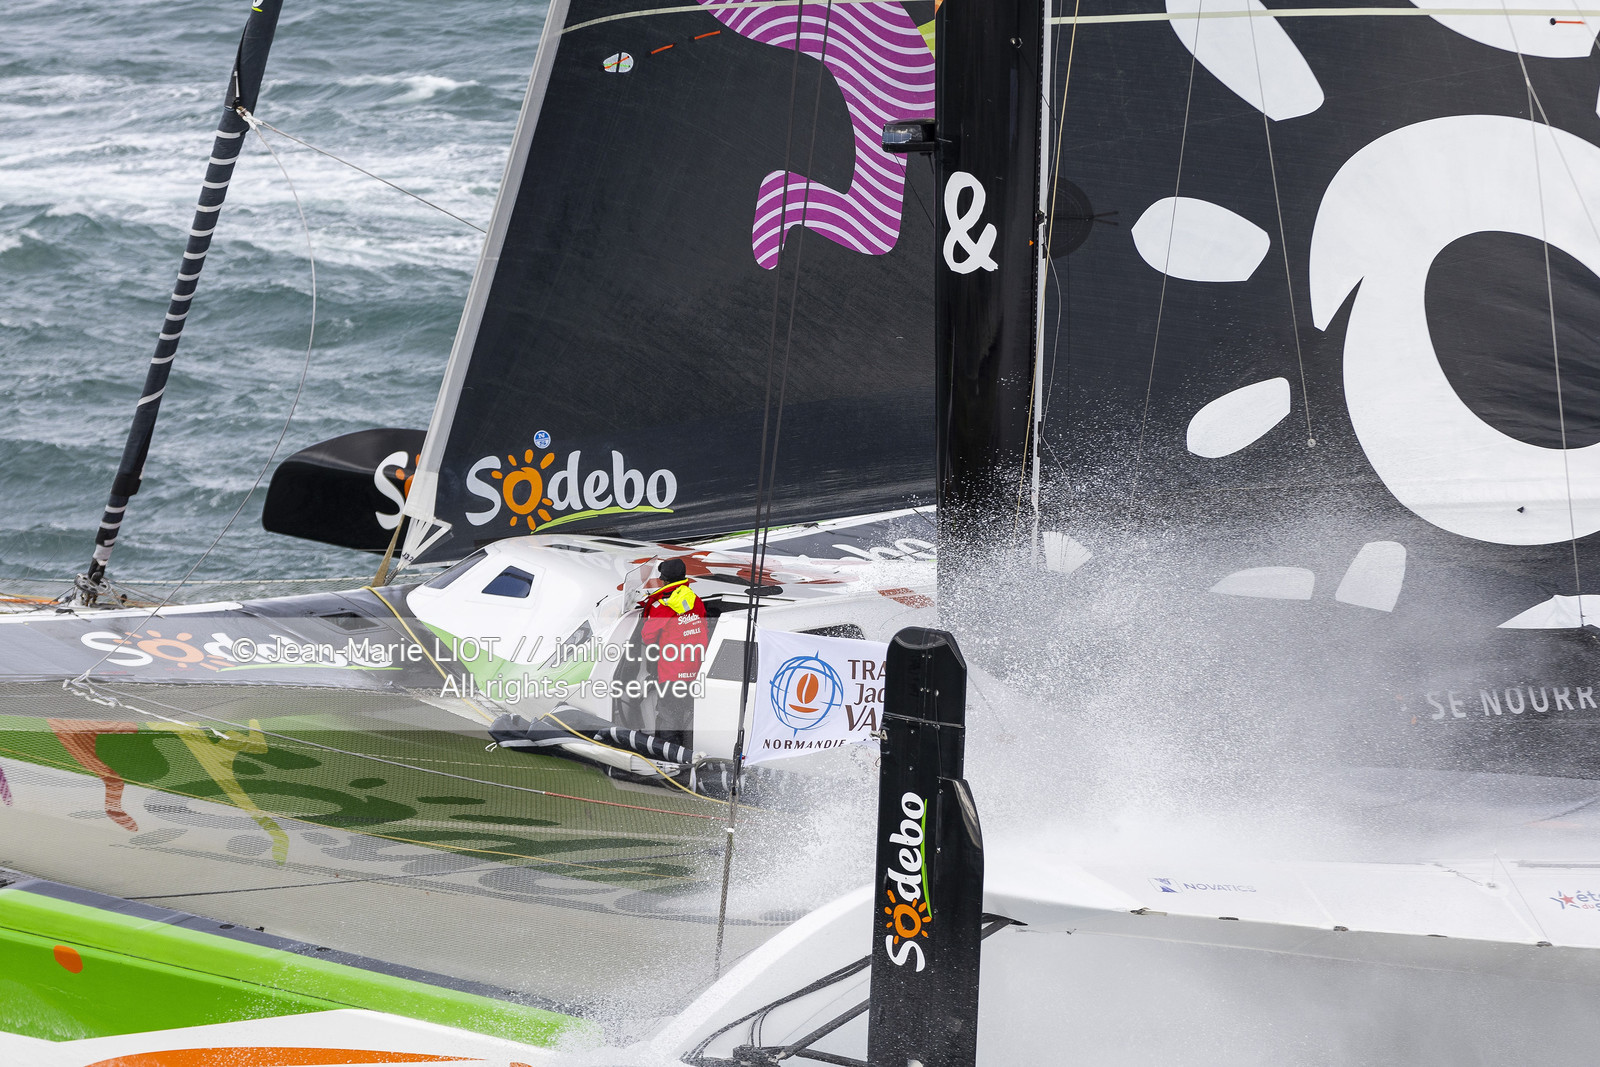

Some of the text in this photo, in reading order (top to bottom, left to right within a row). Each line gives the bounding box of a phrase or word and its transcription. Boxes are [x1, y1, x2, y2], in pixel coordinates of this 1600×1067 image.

[943, 171, 998, 274] &
[465, 449, 677, 527] Sodebo
[885, 791, 931, 973] Sodebo
[1183, 882, 1257, 893] NOVATICS
